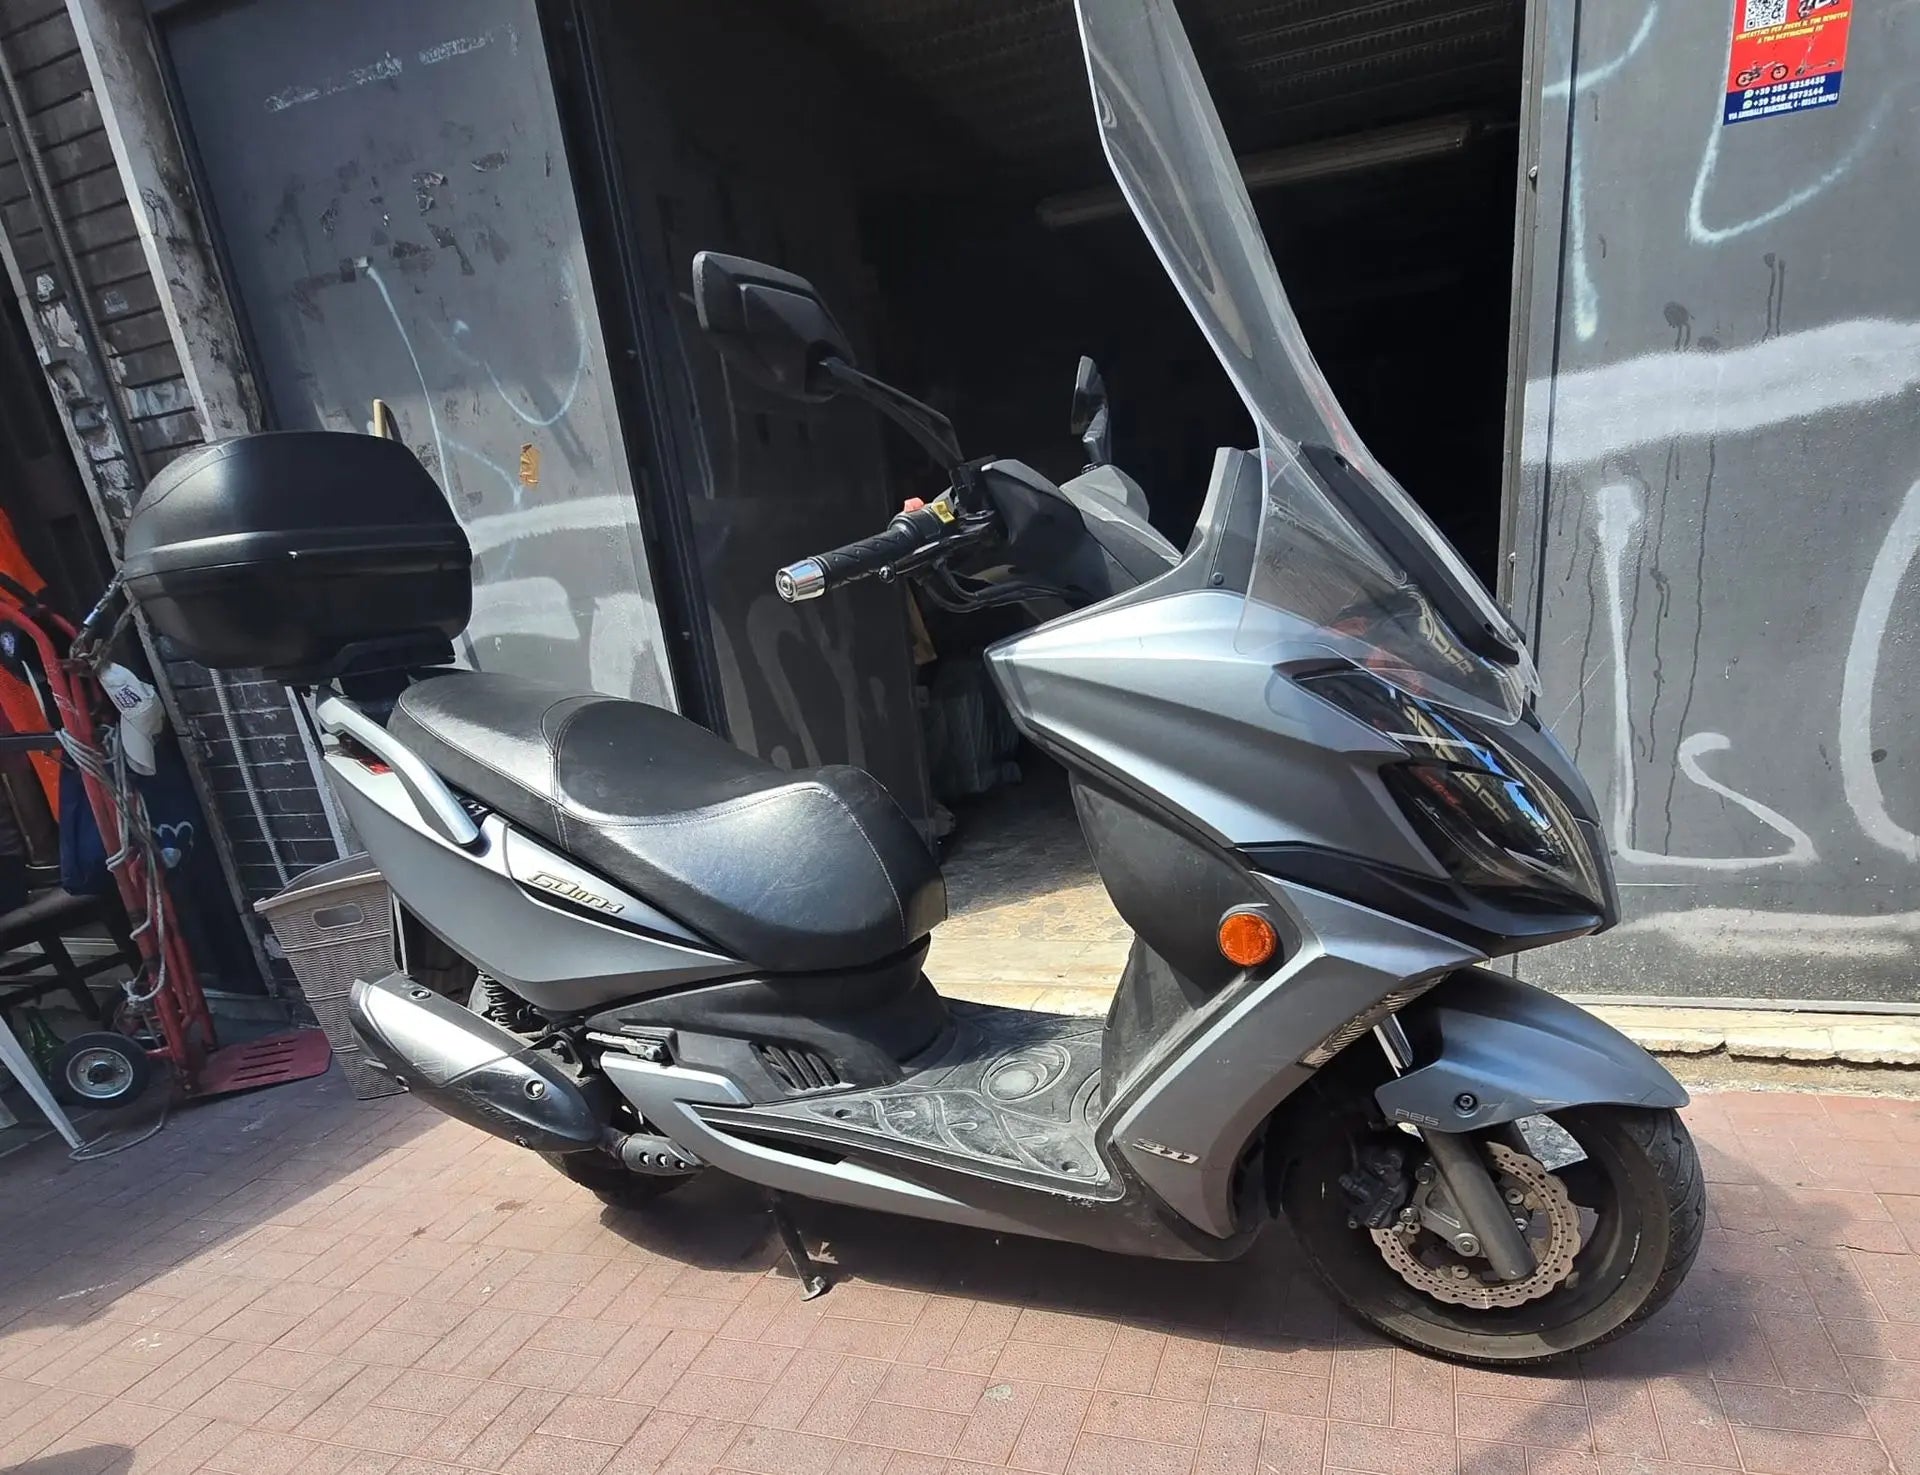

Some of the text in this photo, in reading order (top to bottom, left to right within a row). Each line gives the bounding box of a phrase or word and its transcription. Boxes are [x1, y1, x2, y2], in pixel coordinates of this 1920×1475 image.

[1755, 87, 1770, 96] +39
[1753, 97, 1769, 107] +39
[1395, 1108, 1440, 1127] ABS
